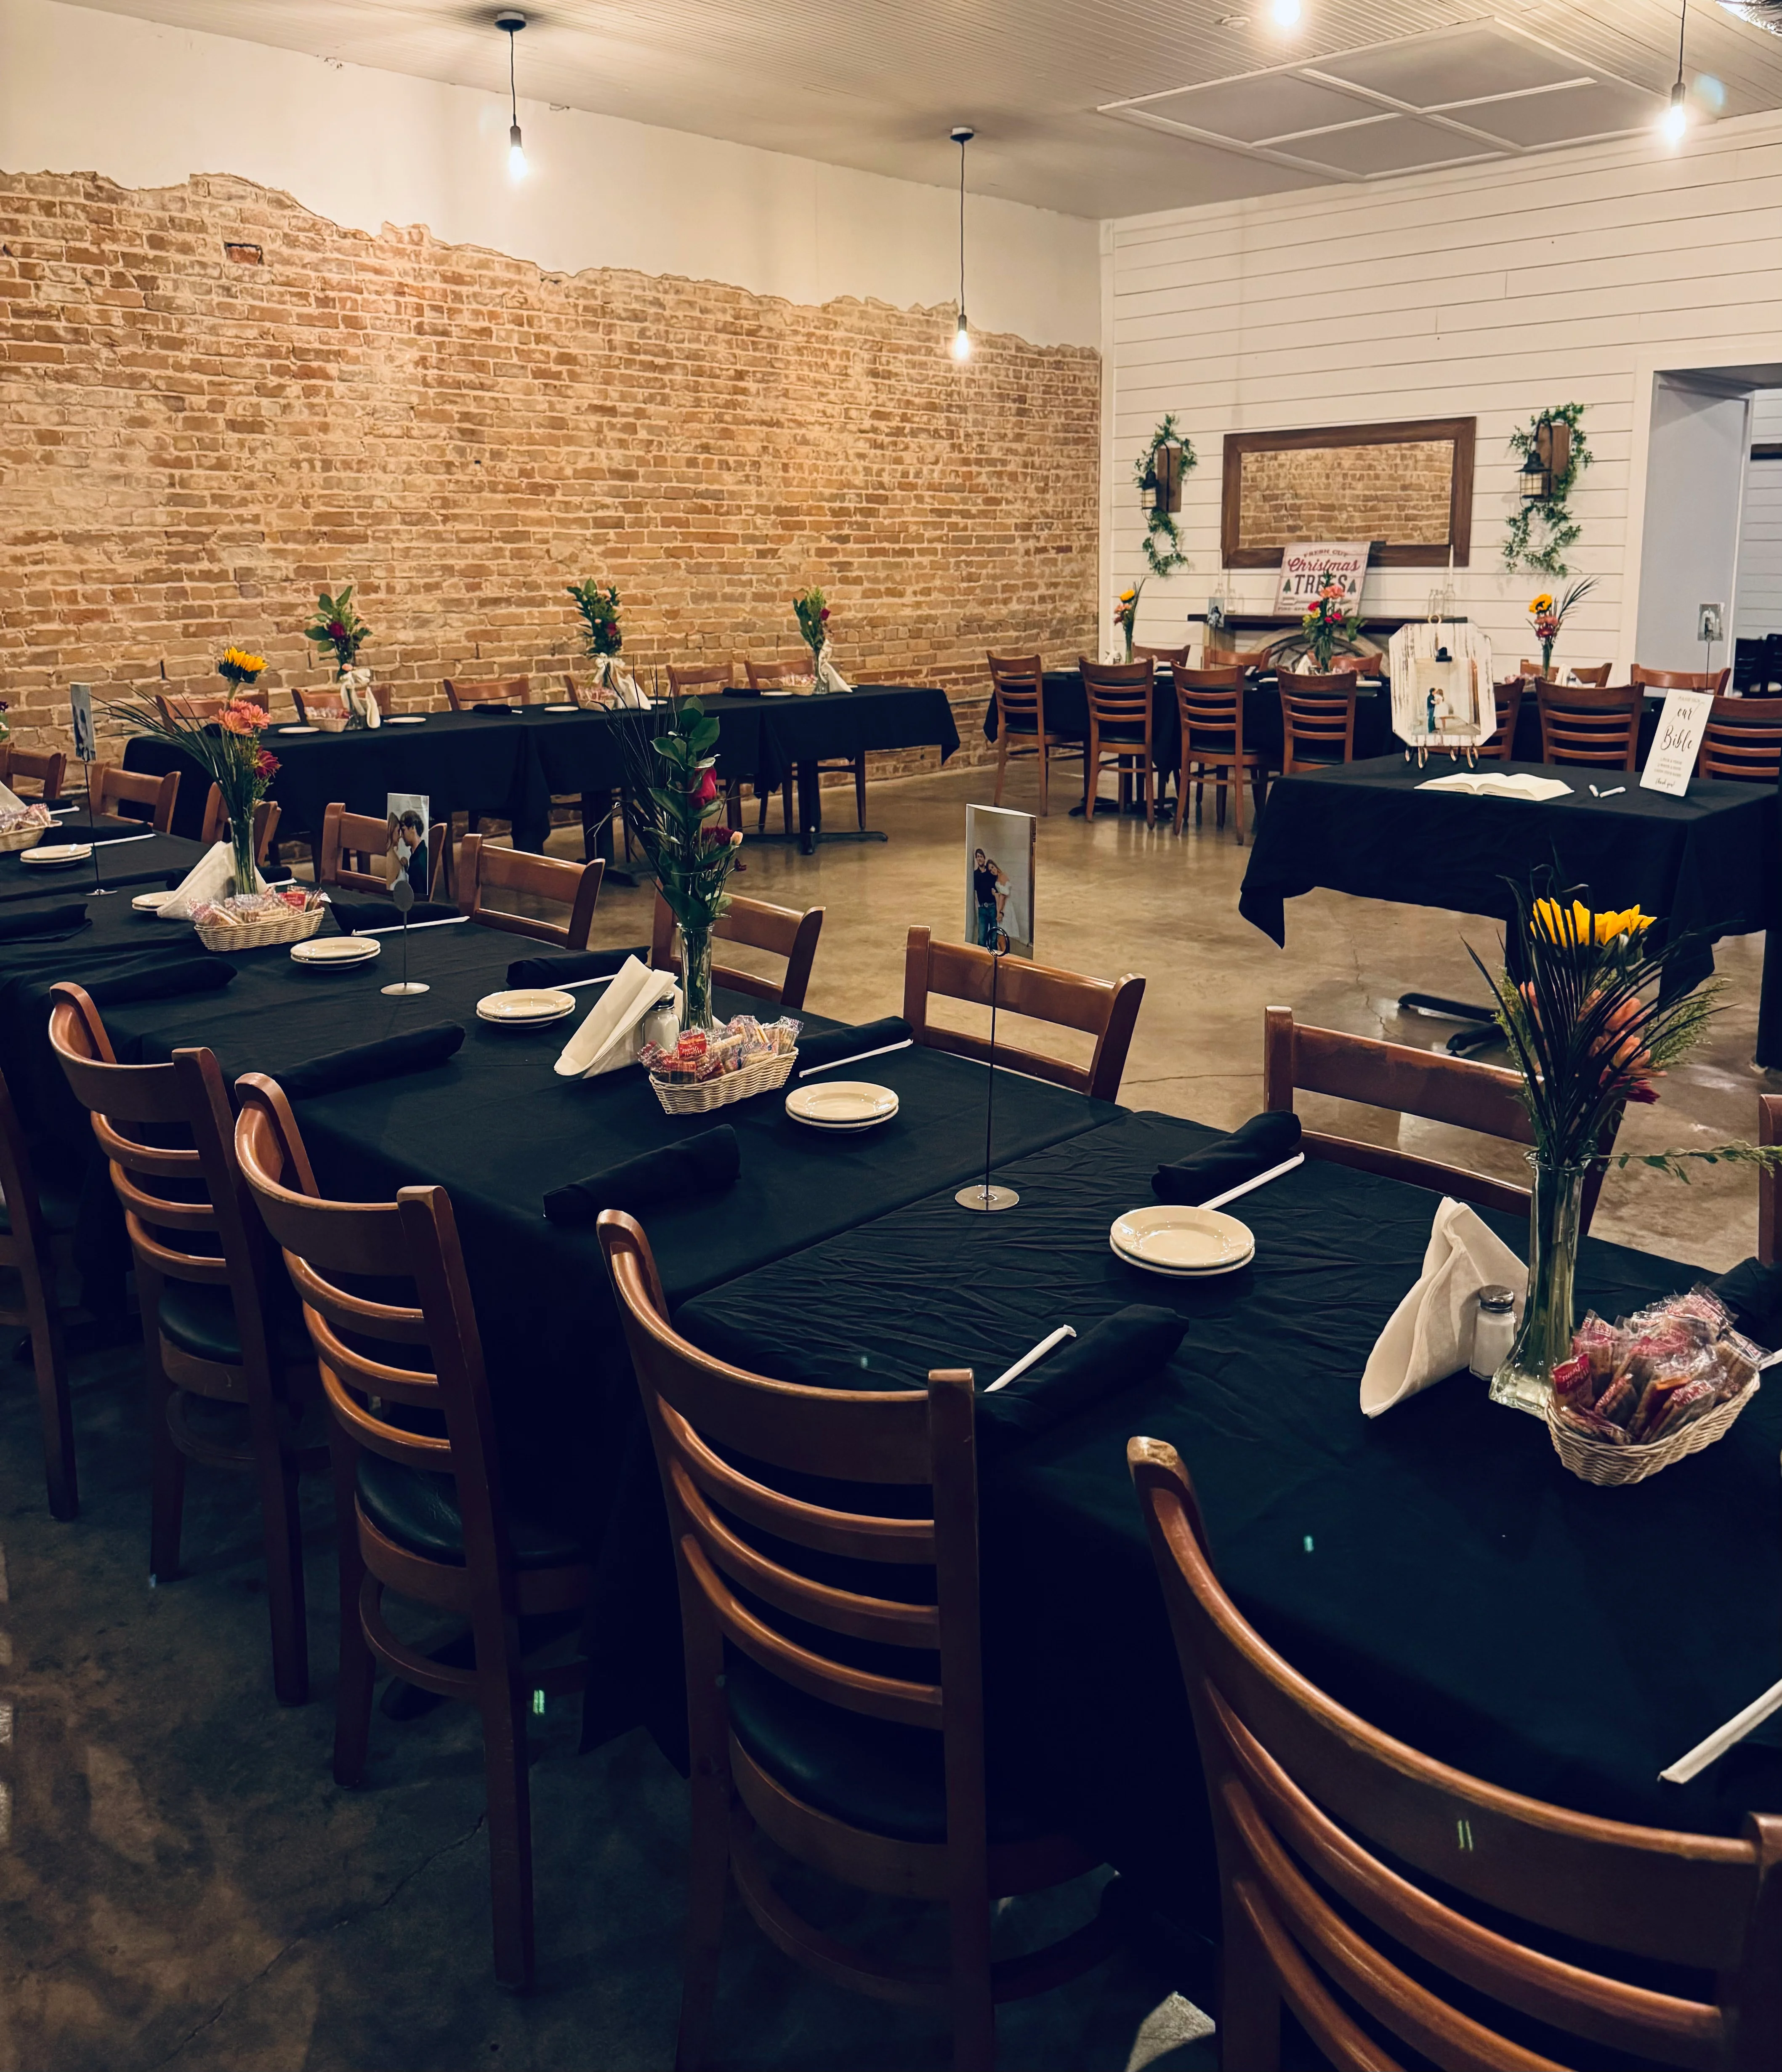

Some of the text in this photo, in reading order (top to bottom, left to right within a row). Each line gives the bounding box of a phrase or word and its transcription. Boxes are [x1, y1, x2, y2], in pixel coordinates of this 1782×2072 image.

[1287, 557, 1360, 572] Christmas
[1295, 574, 1348, 595] TRES
[1660, 724, 1694, 752] Bible
